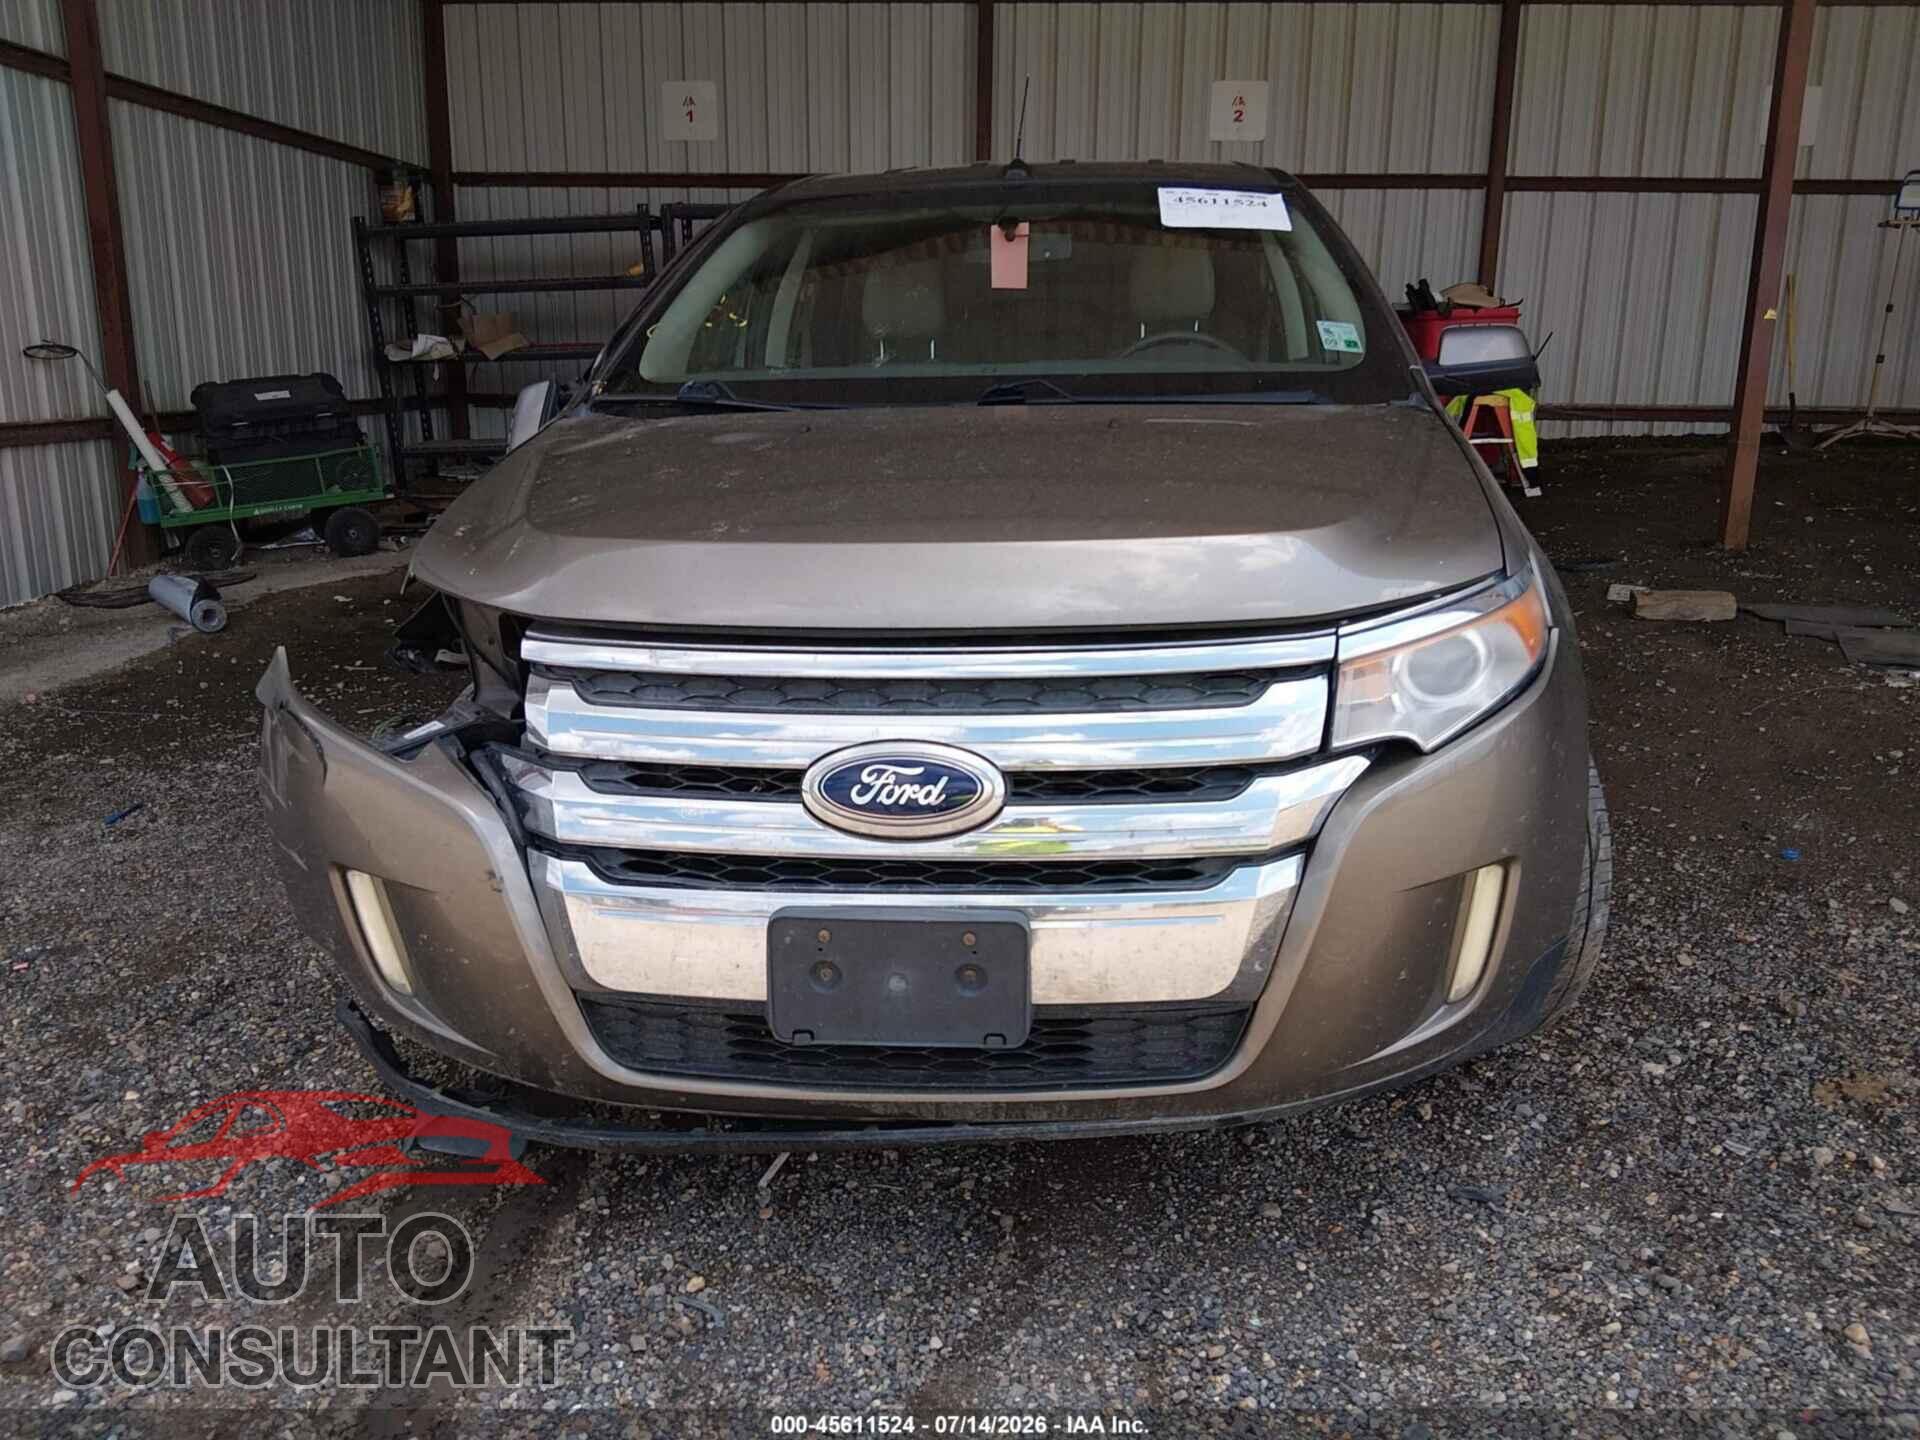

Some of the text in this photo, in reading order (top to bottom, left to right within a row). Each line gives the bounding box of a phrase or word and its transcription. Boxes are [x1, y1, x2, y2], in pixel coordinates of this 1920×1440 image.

[685, 110, 693, 123] 1
[1233, 110, 1243, 122] 2
[851, 764, 949, 805] Ford
